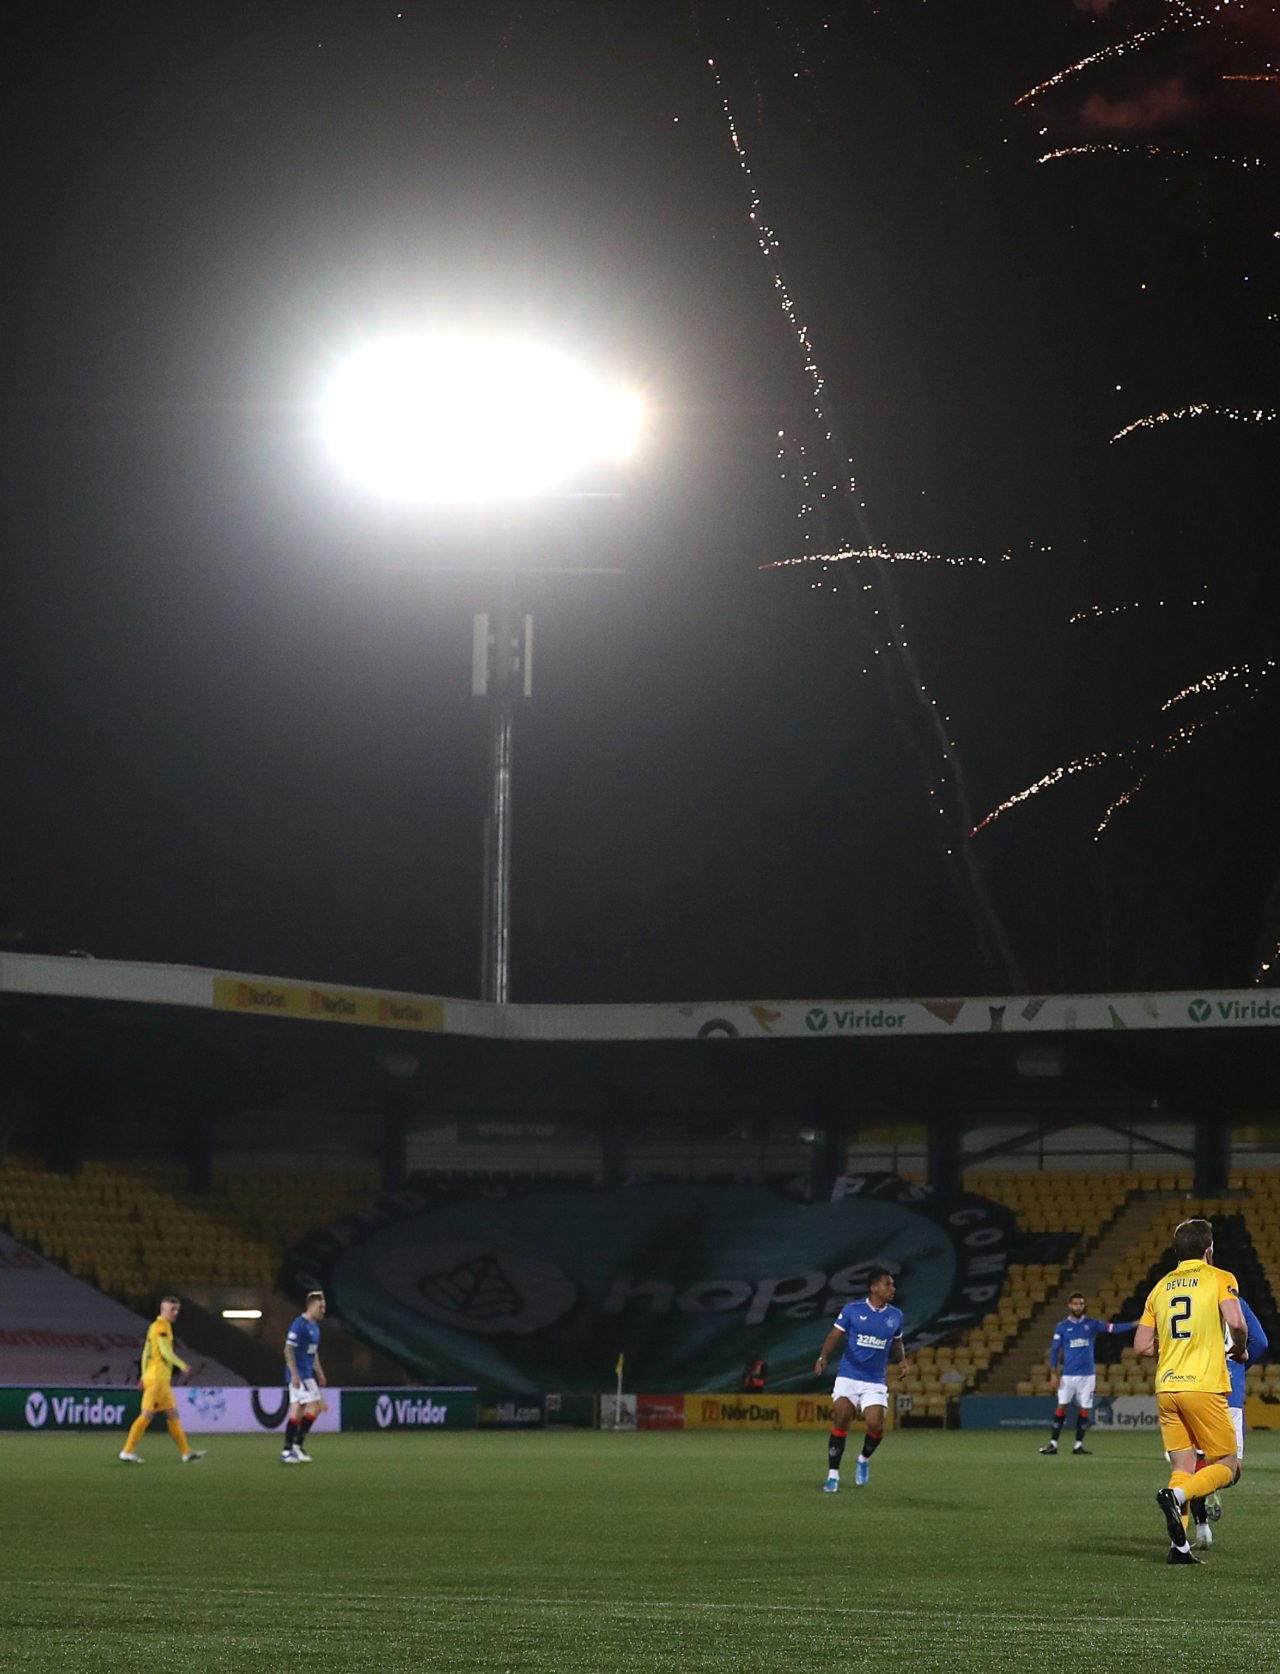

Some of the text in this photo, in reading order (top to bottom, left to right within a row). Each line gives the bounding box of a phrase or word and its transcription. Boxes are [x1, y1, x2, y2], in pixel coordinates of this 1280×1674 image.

[833, 1009, 907, 1031] Viridor
[1166, 1278, 1199, 1291] DEVLIN
[1169, 1295, 1192, 1340] 2
[856, 1333, 888, 1347] 32Red
[52, 1396, 126, 1425] Viridor
[394, 1399, 447, 1425] Viridor
[720, 1404, 780, 1422] NorDan
